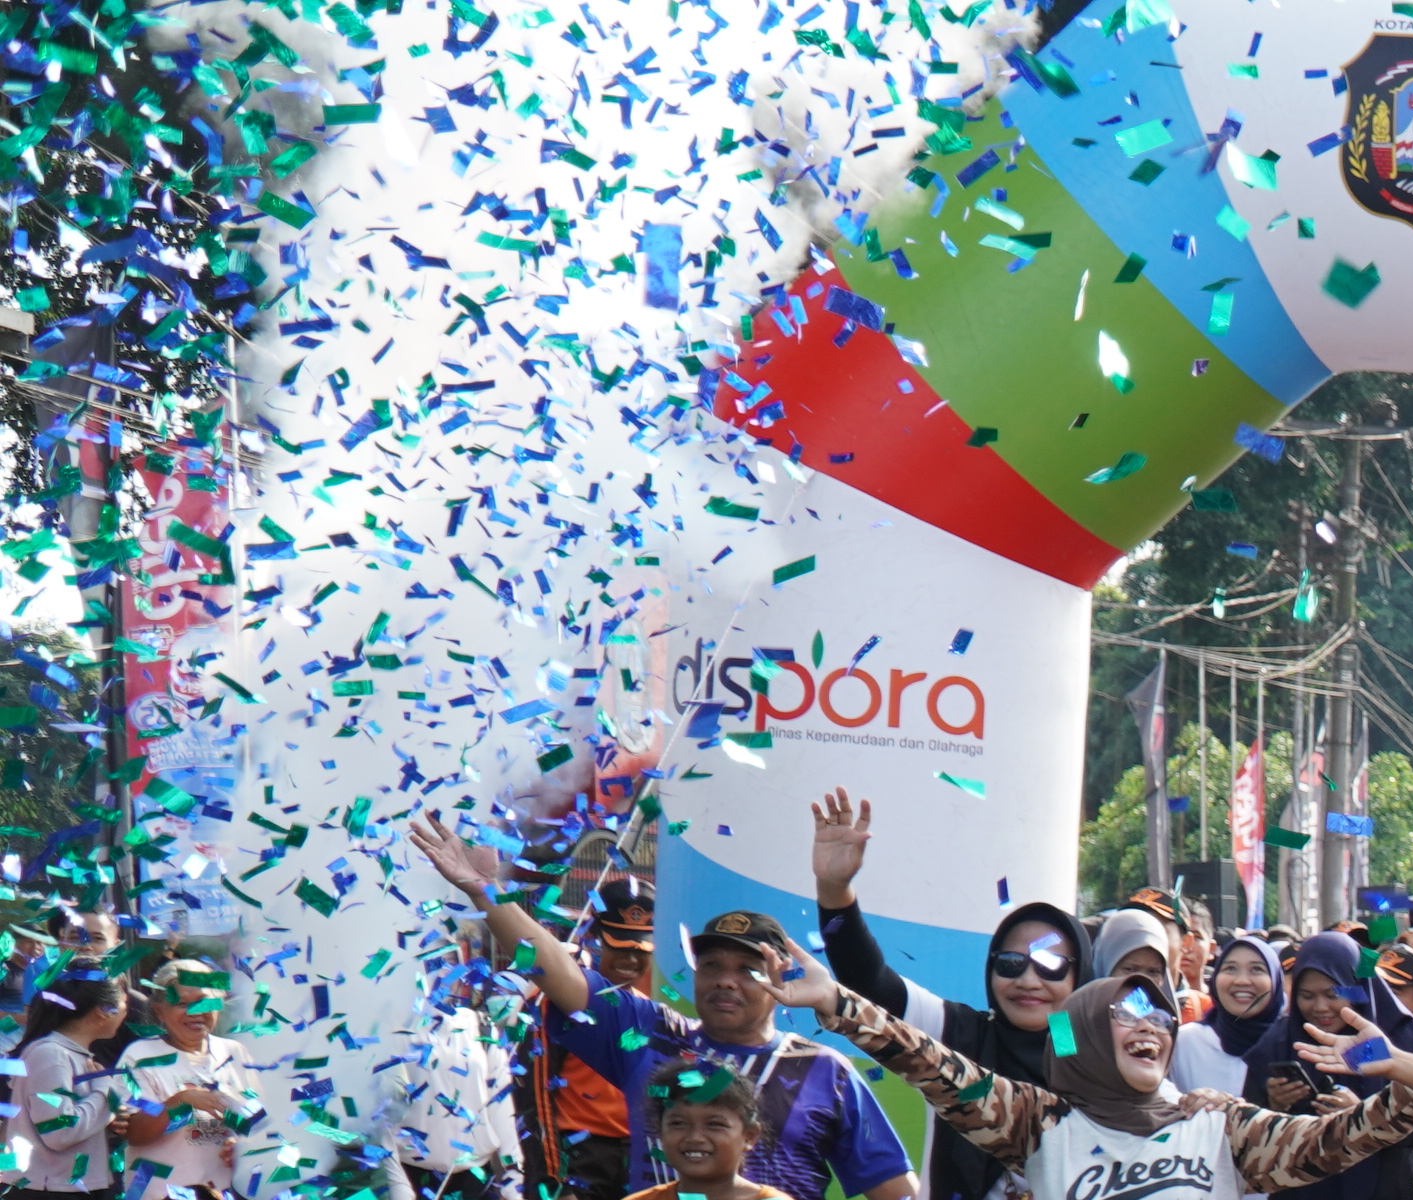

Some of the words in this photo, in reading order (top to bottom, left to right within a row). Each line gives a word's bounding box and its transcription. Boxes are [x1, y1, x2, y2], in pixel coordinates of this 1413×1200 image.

[672, 637, 986, 742] dispora
[805, 729, 896, 748] Kepemudaan
[899, 736, 925, 751] dan
[928, 739, 984, 758] Olahraga
